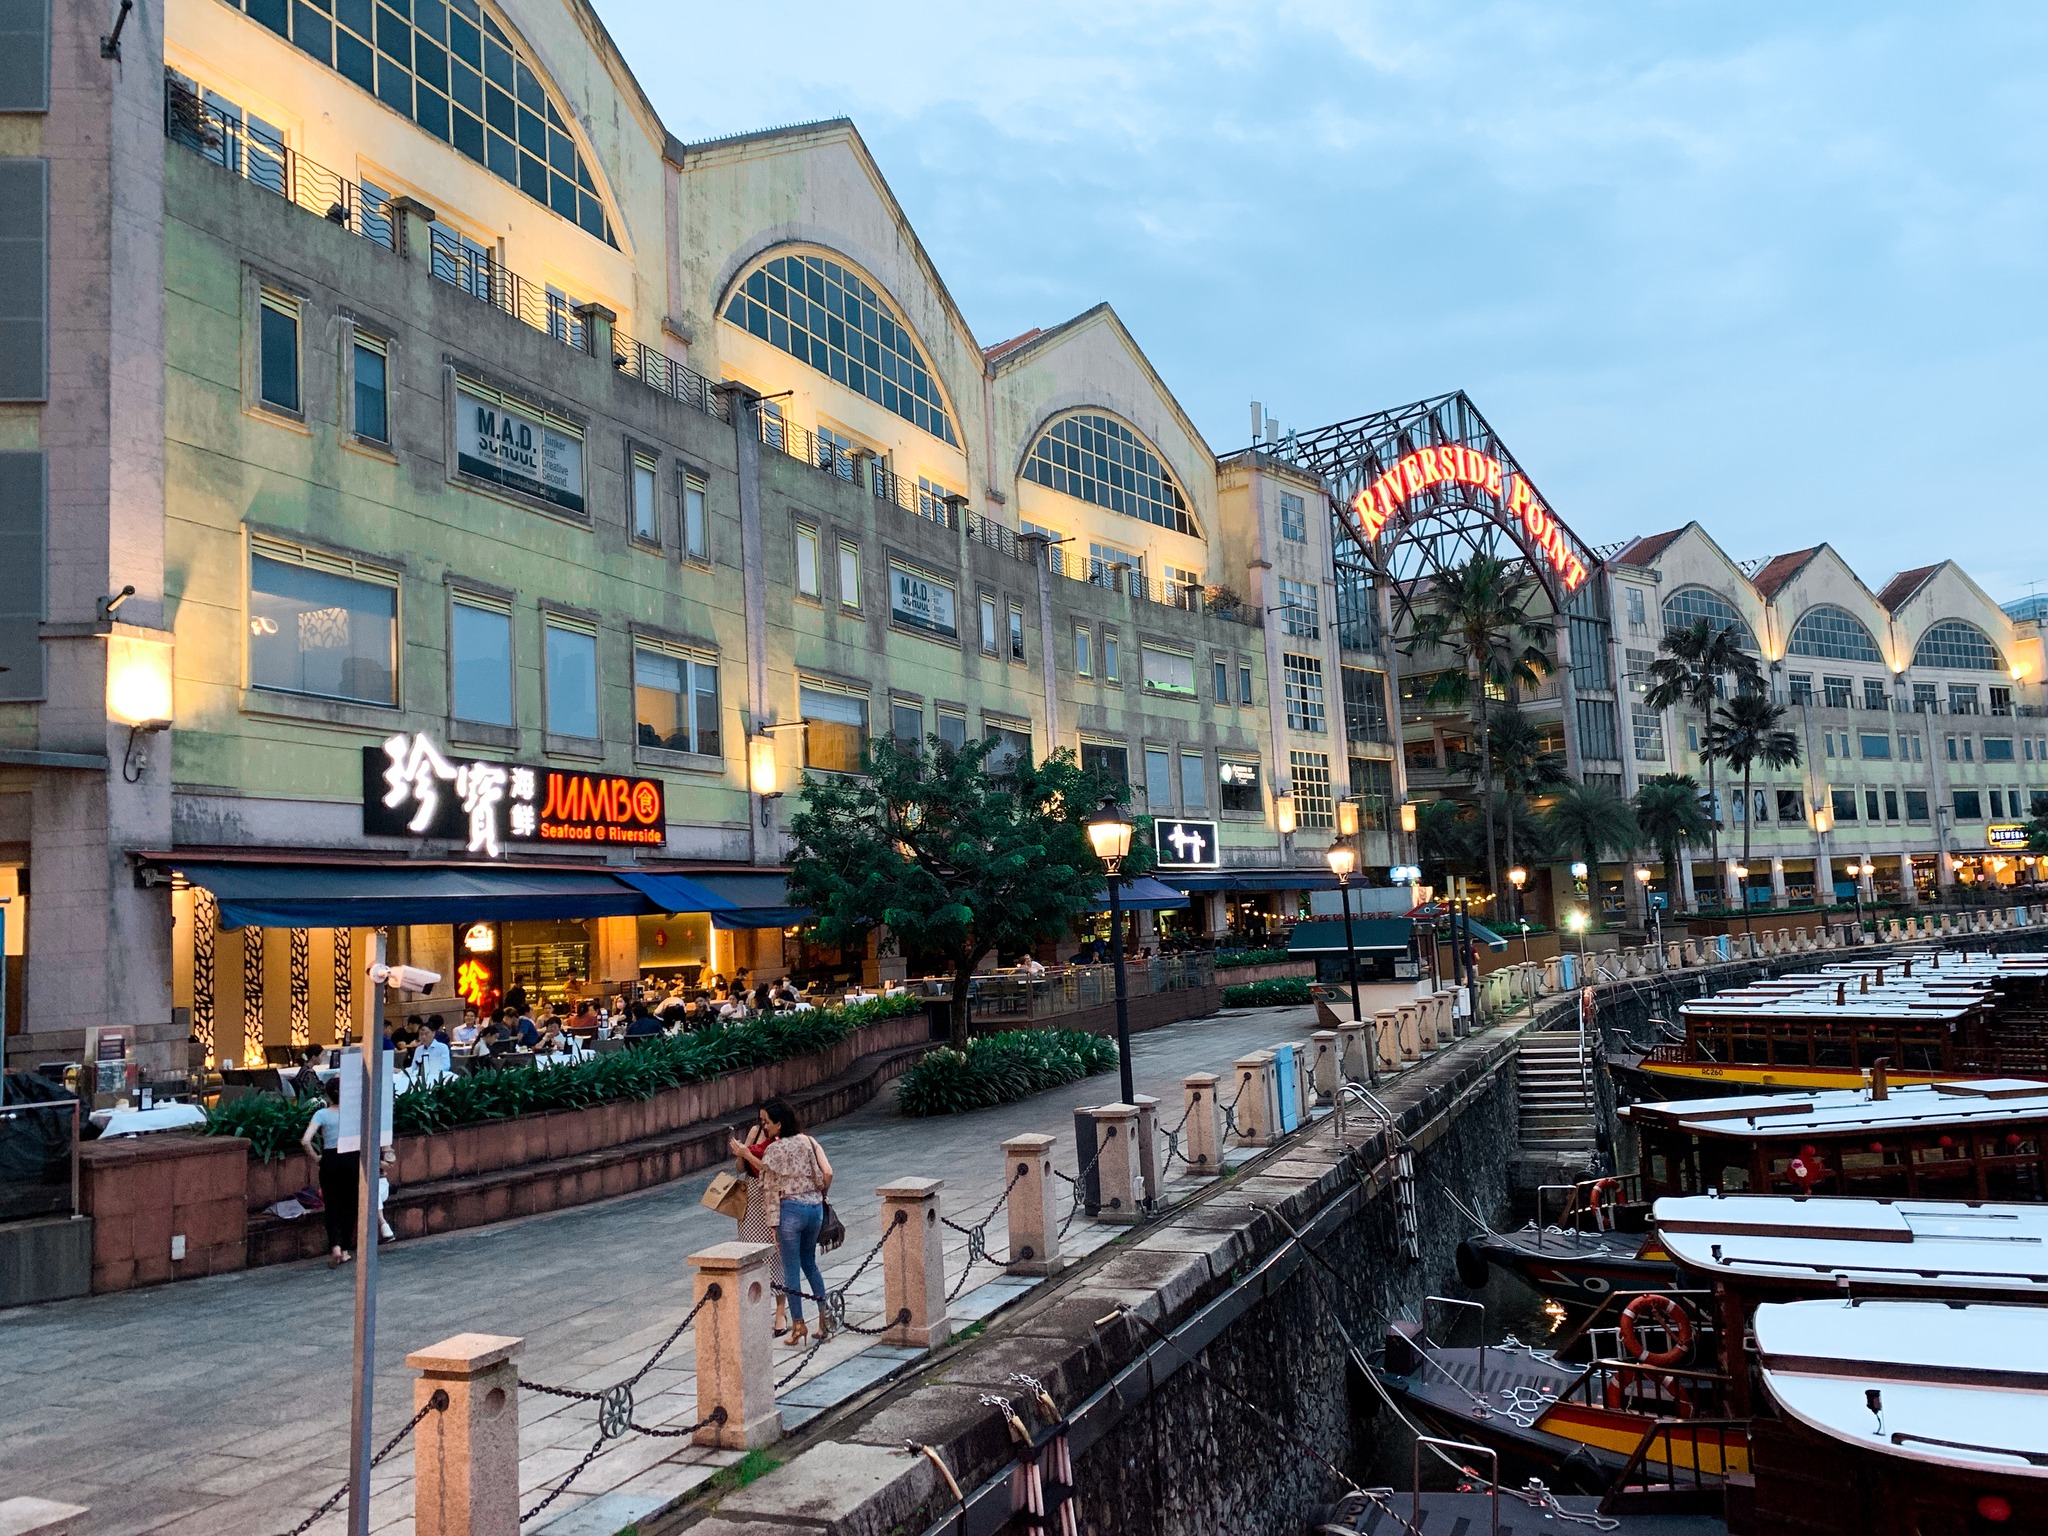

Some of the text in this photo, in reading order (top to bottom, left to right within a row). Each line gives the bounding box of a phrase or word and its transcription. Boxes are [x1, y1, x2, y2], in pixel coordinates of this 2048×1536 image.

[477, 407, 537, 454] M.A.D.
[541, 456, 569, 476] Creative
[1353, 446, 1587, 591] RIVERSIDE POINT
[901, 576, 930, 603] M.A.D.
[540, 773, 660, 825] JUMBO
[540, 822, 662, 843] Seafood @ Riverside
